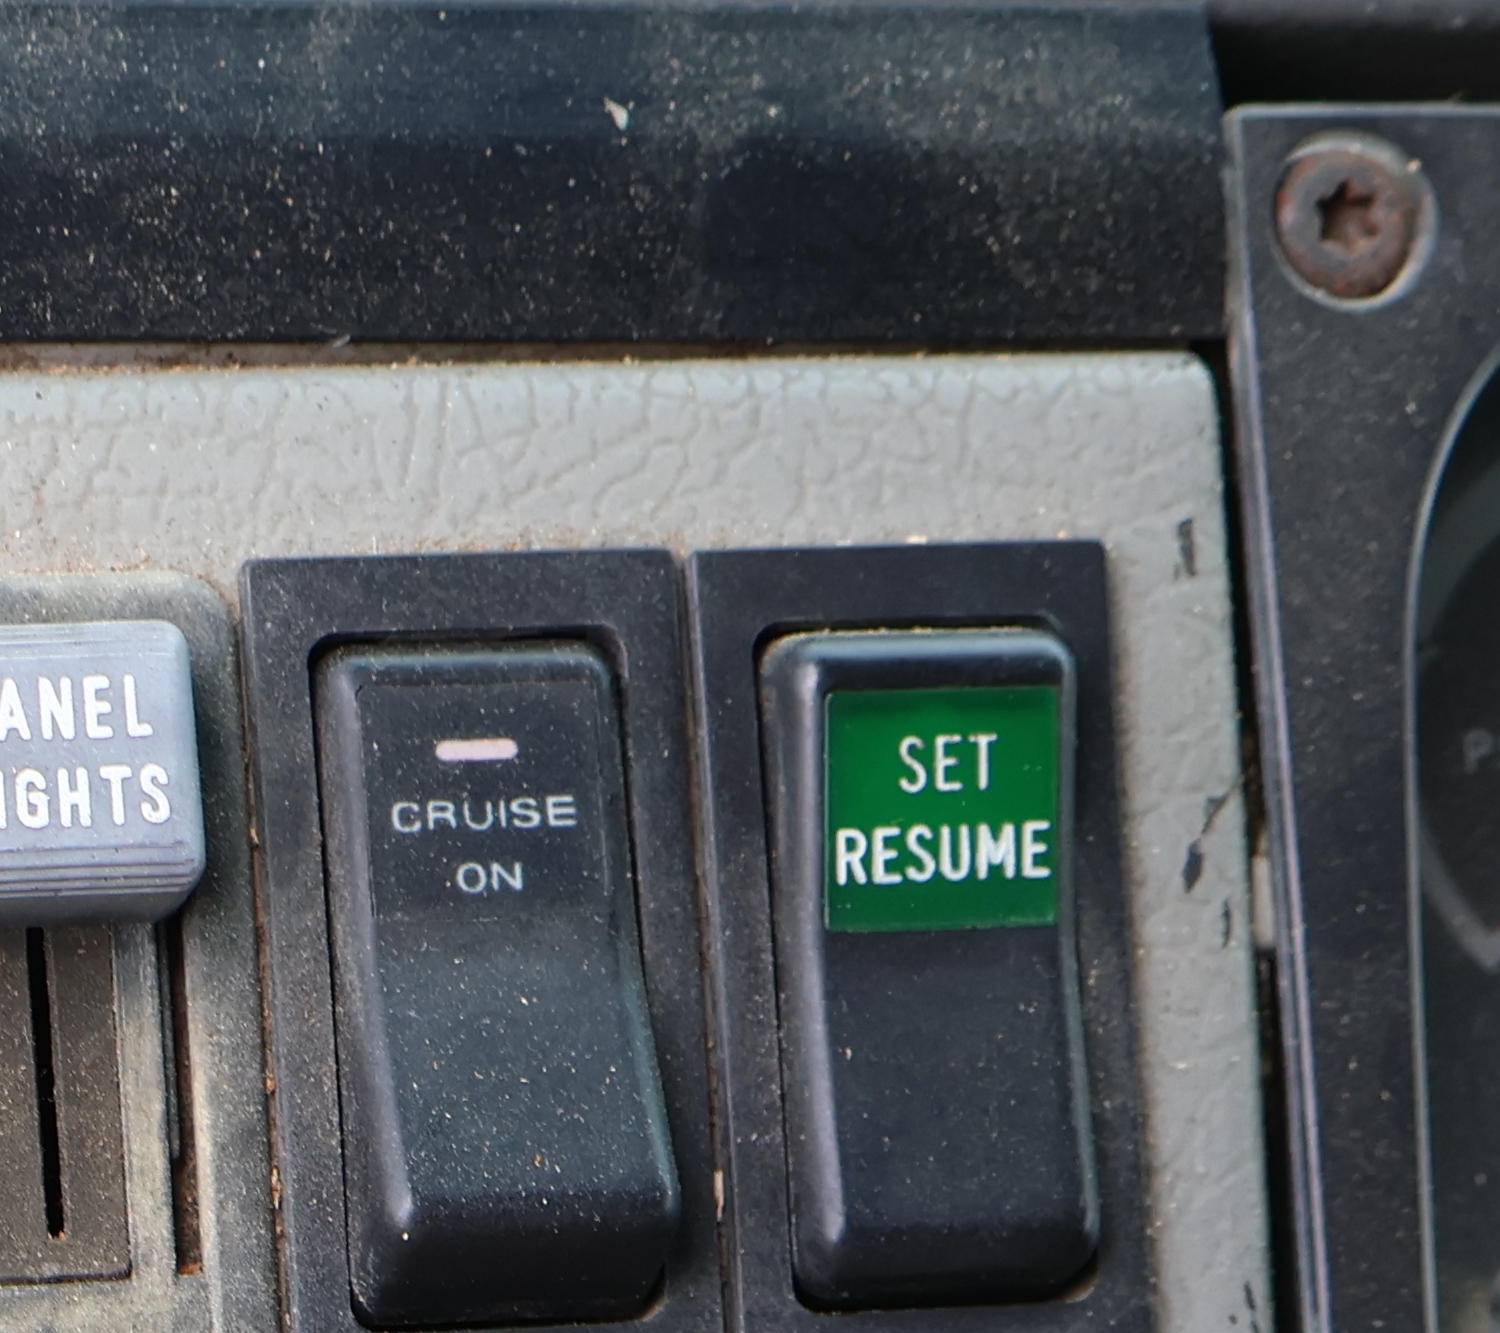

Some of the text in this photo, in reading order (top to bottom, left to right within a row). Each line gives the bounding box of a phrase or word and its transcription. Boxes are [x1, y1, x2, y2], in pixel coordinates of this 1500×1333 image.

[897, 732, 999, 794] SET
[391, 794, 580, 834] CRUISE
[456, 860, 525, 895] ON
[835, 818, 1053, 887] RESUME
